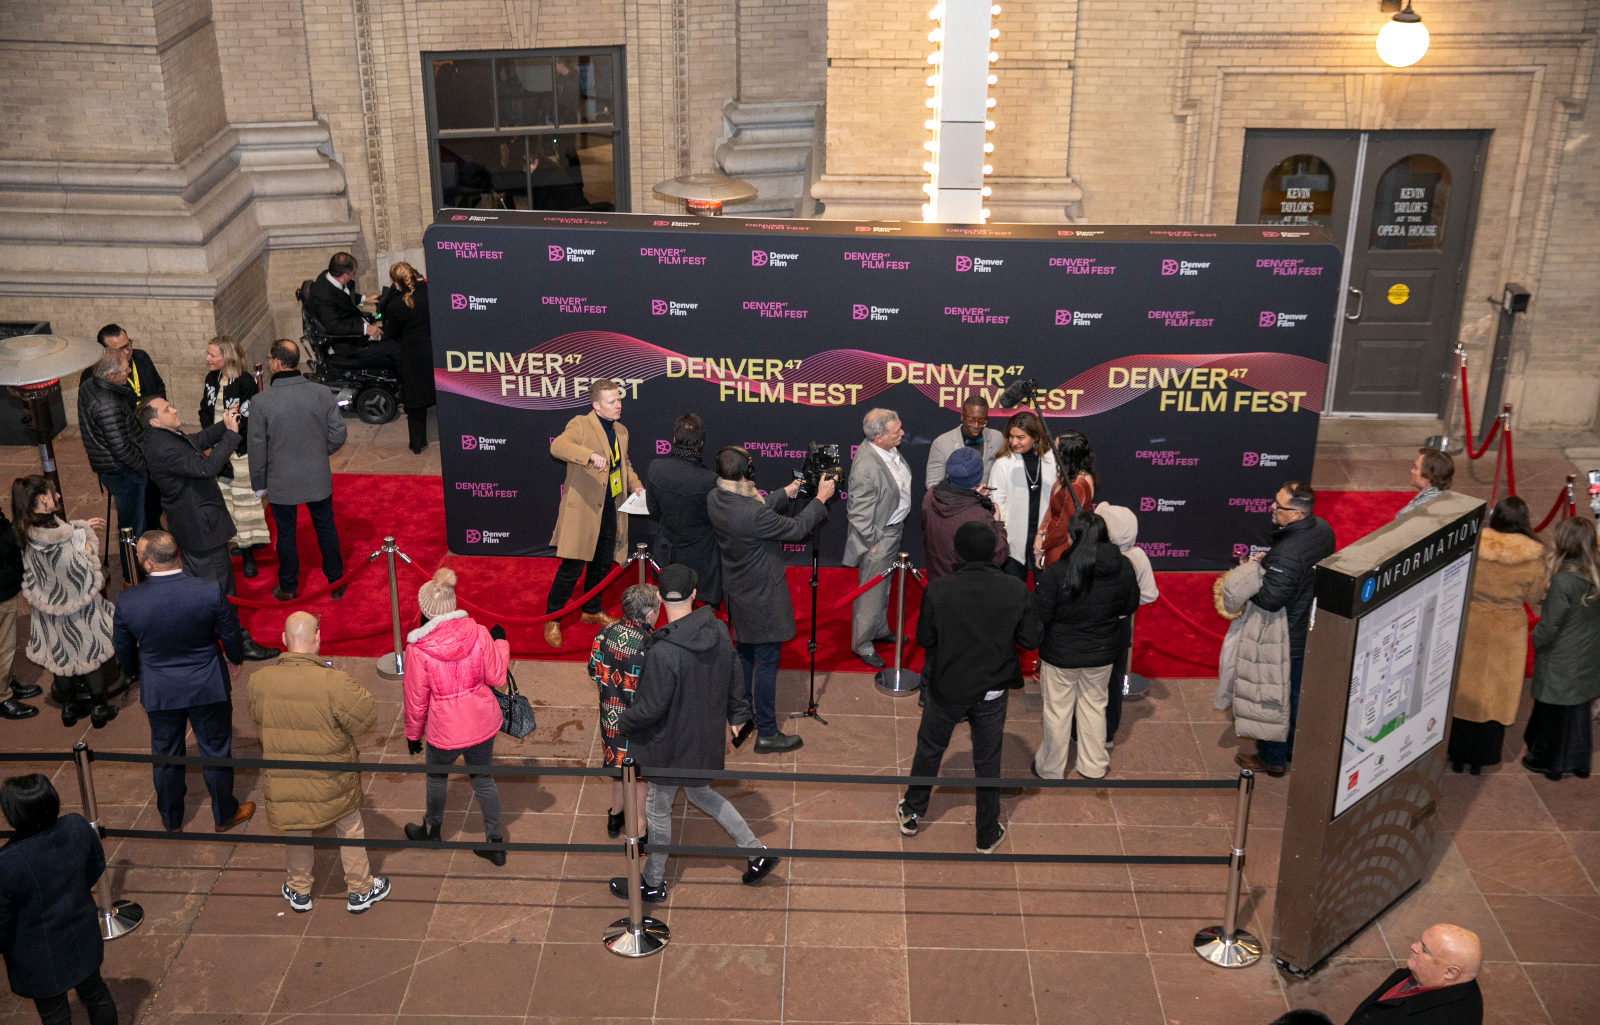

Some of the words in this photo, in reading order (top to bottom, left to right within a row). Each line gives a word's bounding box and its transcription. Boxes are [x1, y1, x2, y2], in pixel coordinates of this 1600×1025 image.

[1286, 188, 1311, 198] KEVIN
[1400, 188, 1425, 199] KEVIN
[1280, 202, 1314, 213] TAYLOR'S
[1394, 202, 1428, 213] TAYLOR'S
[1377, 225, 1406, 236] OPERA
[1408, 225, 1437, 236] HOUSE
[456, 250, 478, 259] FILM
[480, 251, 503, 260] FEST
[566, 247, 595, 256] Denver
[770, 252, 799, 260] Denver
[566, 254, 584, 262] Film
[658, 256, 681, 265] FILM
[682, 257, 706, 265] FEST
[974, 258, 1003, 266] Denver
[862, 261, 884, 269] FILM
[886, 261, 910, 270] FEST
[1067, 266, 1089, 274] FILM
[1091, 266, 1116, 275] FEST
[1298, 267, 1323, 275] FEST
[469, 296, 498, 304] Denver
[559, 304, 583, 313] FILM
[584, 305, 608, 314] FEST
[670, 302, 698, 310] Denver
[870, 306, 899, 314] Denver
[784, 310, 808, 319] FEST
[962, 315, 984, 323] FILM
[986, 316, 1010, 324] FEST
[1277, 319, 1295, 327] Film
[501, 375, 566, 397] FILM
[574, 377, 644, 400] FST
[720, 381, 785, 403] FILM
[792, 384, 863, 405] FEST
[1160, 391, 1230, 412] FILM
[1233, 392, 1307, 413] FEST
[472, 489, 493, 497] FILM
[495, 490, 517, 498] FEST
[1376, 518, 1479, 592] INFORMATION
